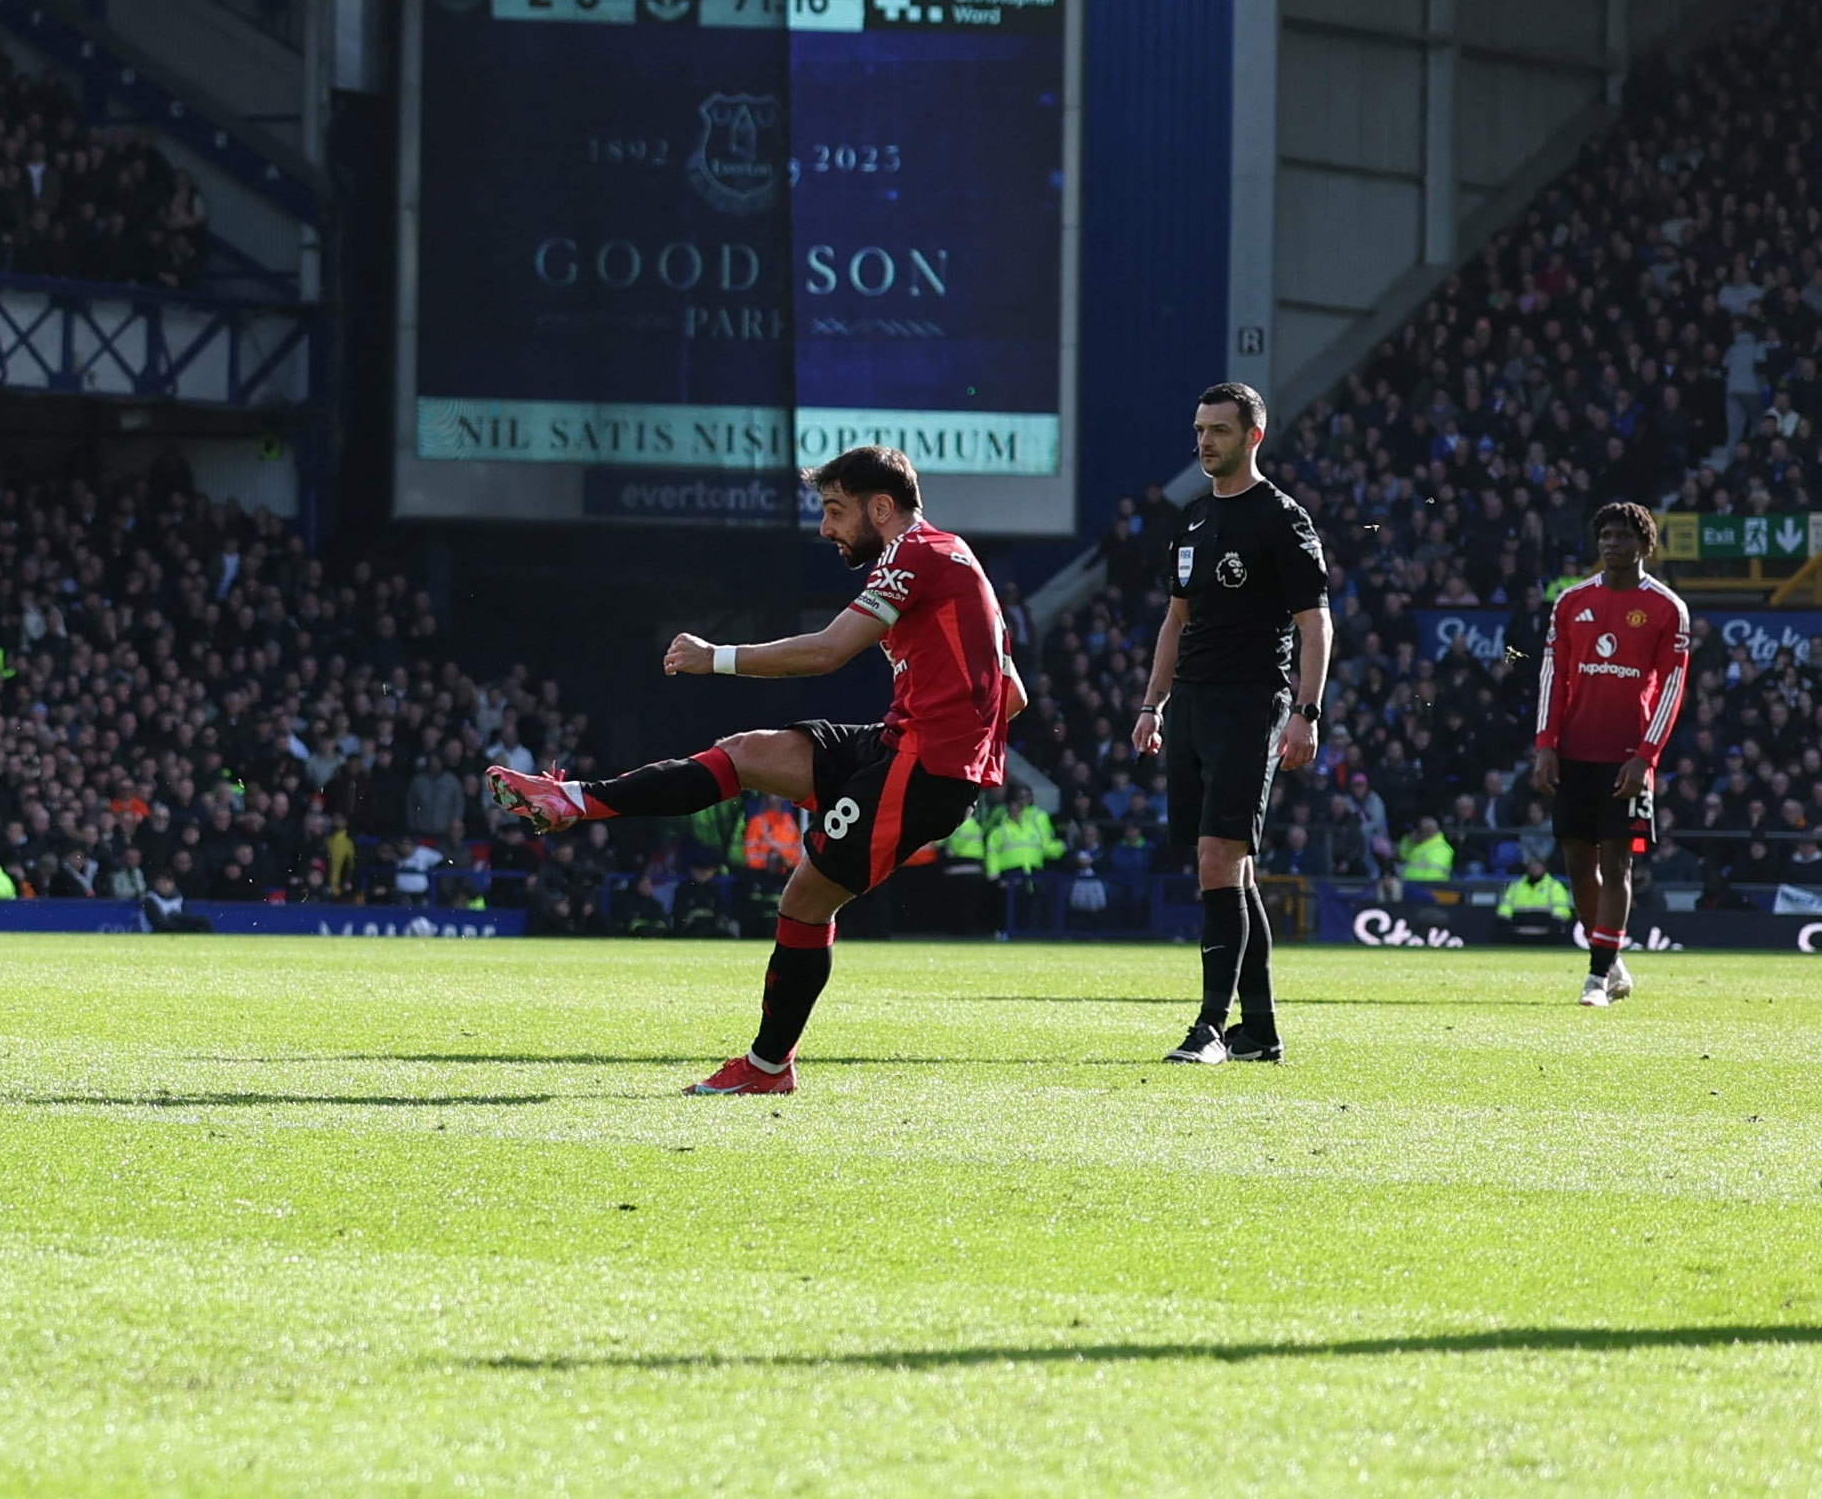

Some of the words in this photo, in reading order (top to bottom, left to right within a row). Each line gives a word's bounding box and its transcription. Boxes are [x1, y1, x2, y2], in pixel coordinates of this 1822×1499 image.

[952, 6, 1000, 26] Ward
[812, 142, 901, 173] 2025
[534, 237, 949, 298] GOODSON
[458, 416, 529, 450] NIL
[549, 419, 674, 453] SATIS
[1703, 527, 1735, 545] Exit
[823, 797, 860, 840] 8
